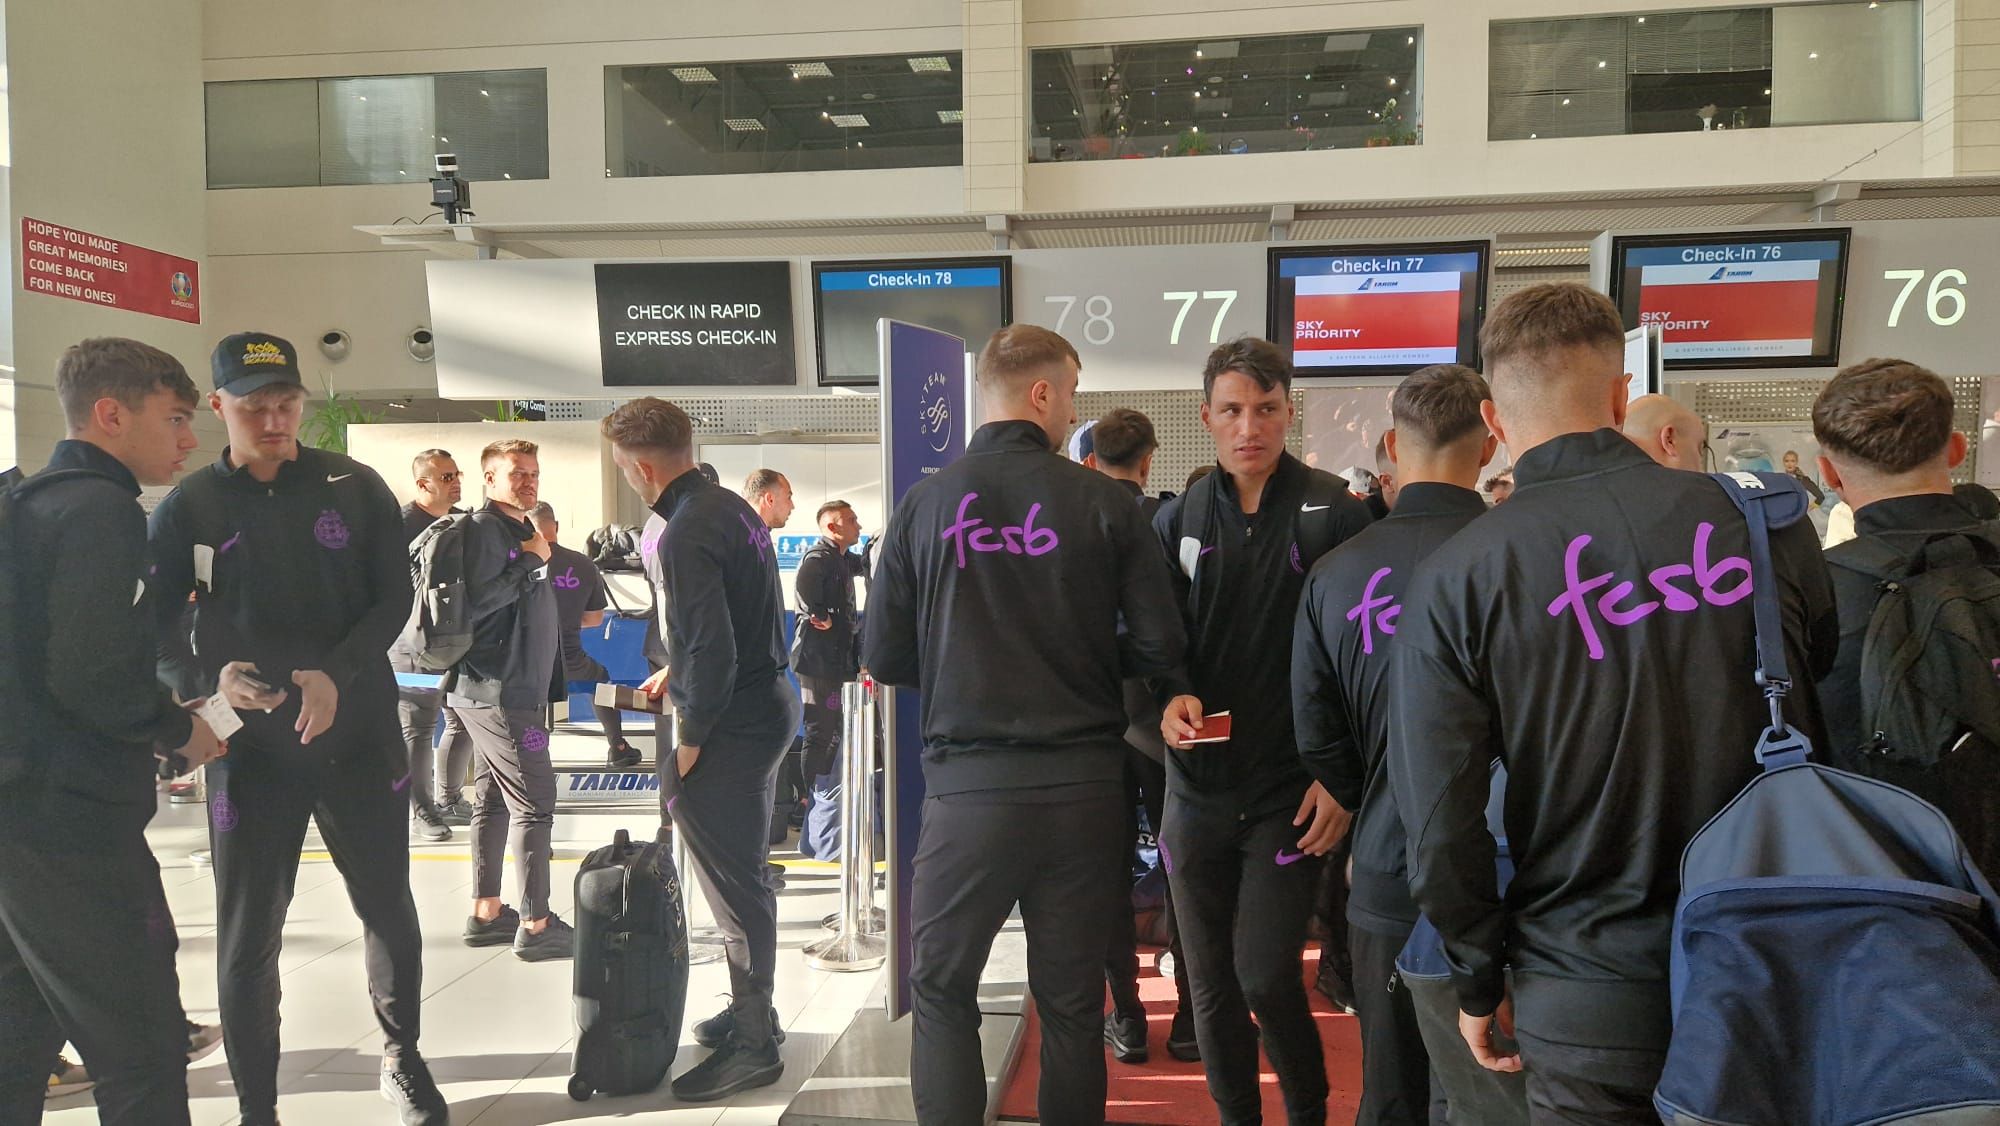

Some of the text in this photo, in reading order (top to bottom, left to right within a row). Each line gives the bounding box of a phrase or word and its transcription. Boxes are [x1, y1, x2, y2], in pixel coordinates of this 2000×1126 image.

[28, 221, 119, 253] HOPE YOU MADE
[28, 239, 128, 273] GREAT MEMORIES!
[1681, 246, 1781, 262] Check-In 76
[29, 258, 95, 283] COME BACK
[1331, 258, 1424, 273] Check-In 77
[868, 272, 952, 286] Check-In 78
[30, 276, 116, 304] FOR NEW ONES!
[1883, 268, 1968, 328] 76
[627, 304, 761, 320] CHECK IN RAPID
[1045, 295, 1115, 345] 78
[1163, 290, 1238, 345] 77
[1640, 312, 1671, 321] SKY
[1295, 329, 1361, 339] PRIORITY
[1296, 320, 1325, 330] SKY
[615, 330, 777, 346] EXPRESS CHECK-IN
[942, 492, 1058, 568] fcsb
[1547, 522, 1753, 660] fcsb
[569, 773, 660, 791] TAROM
